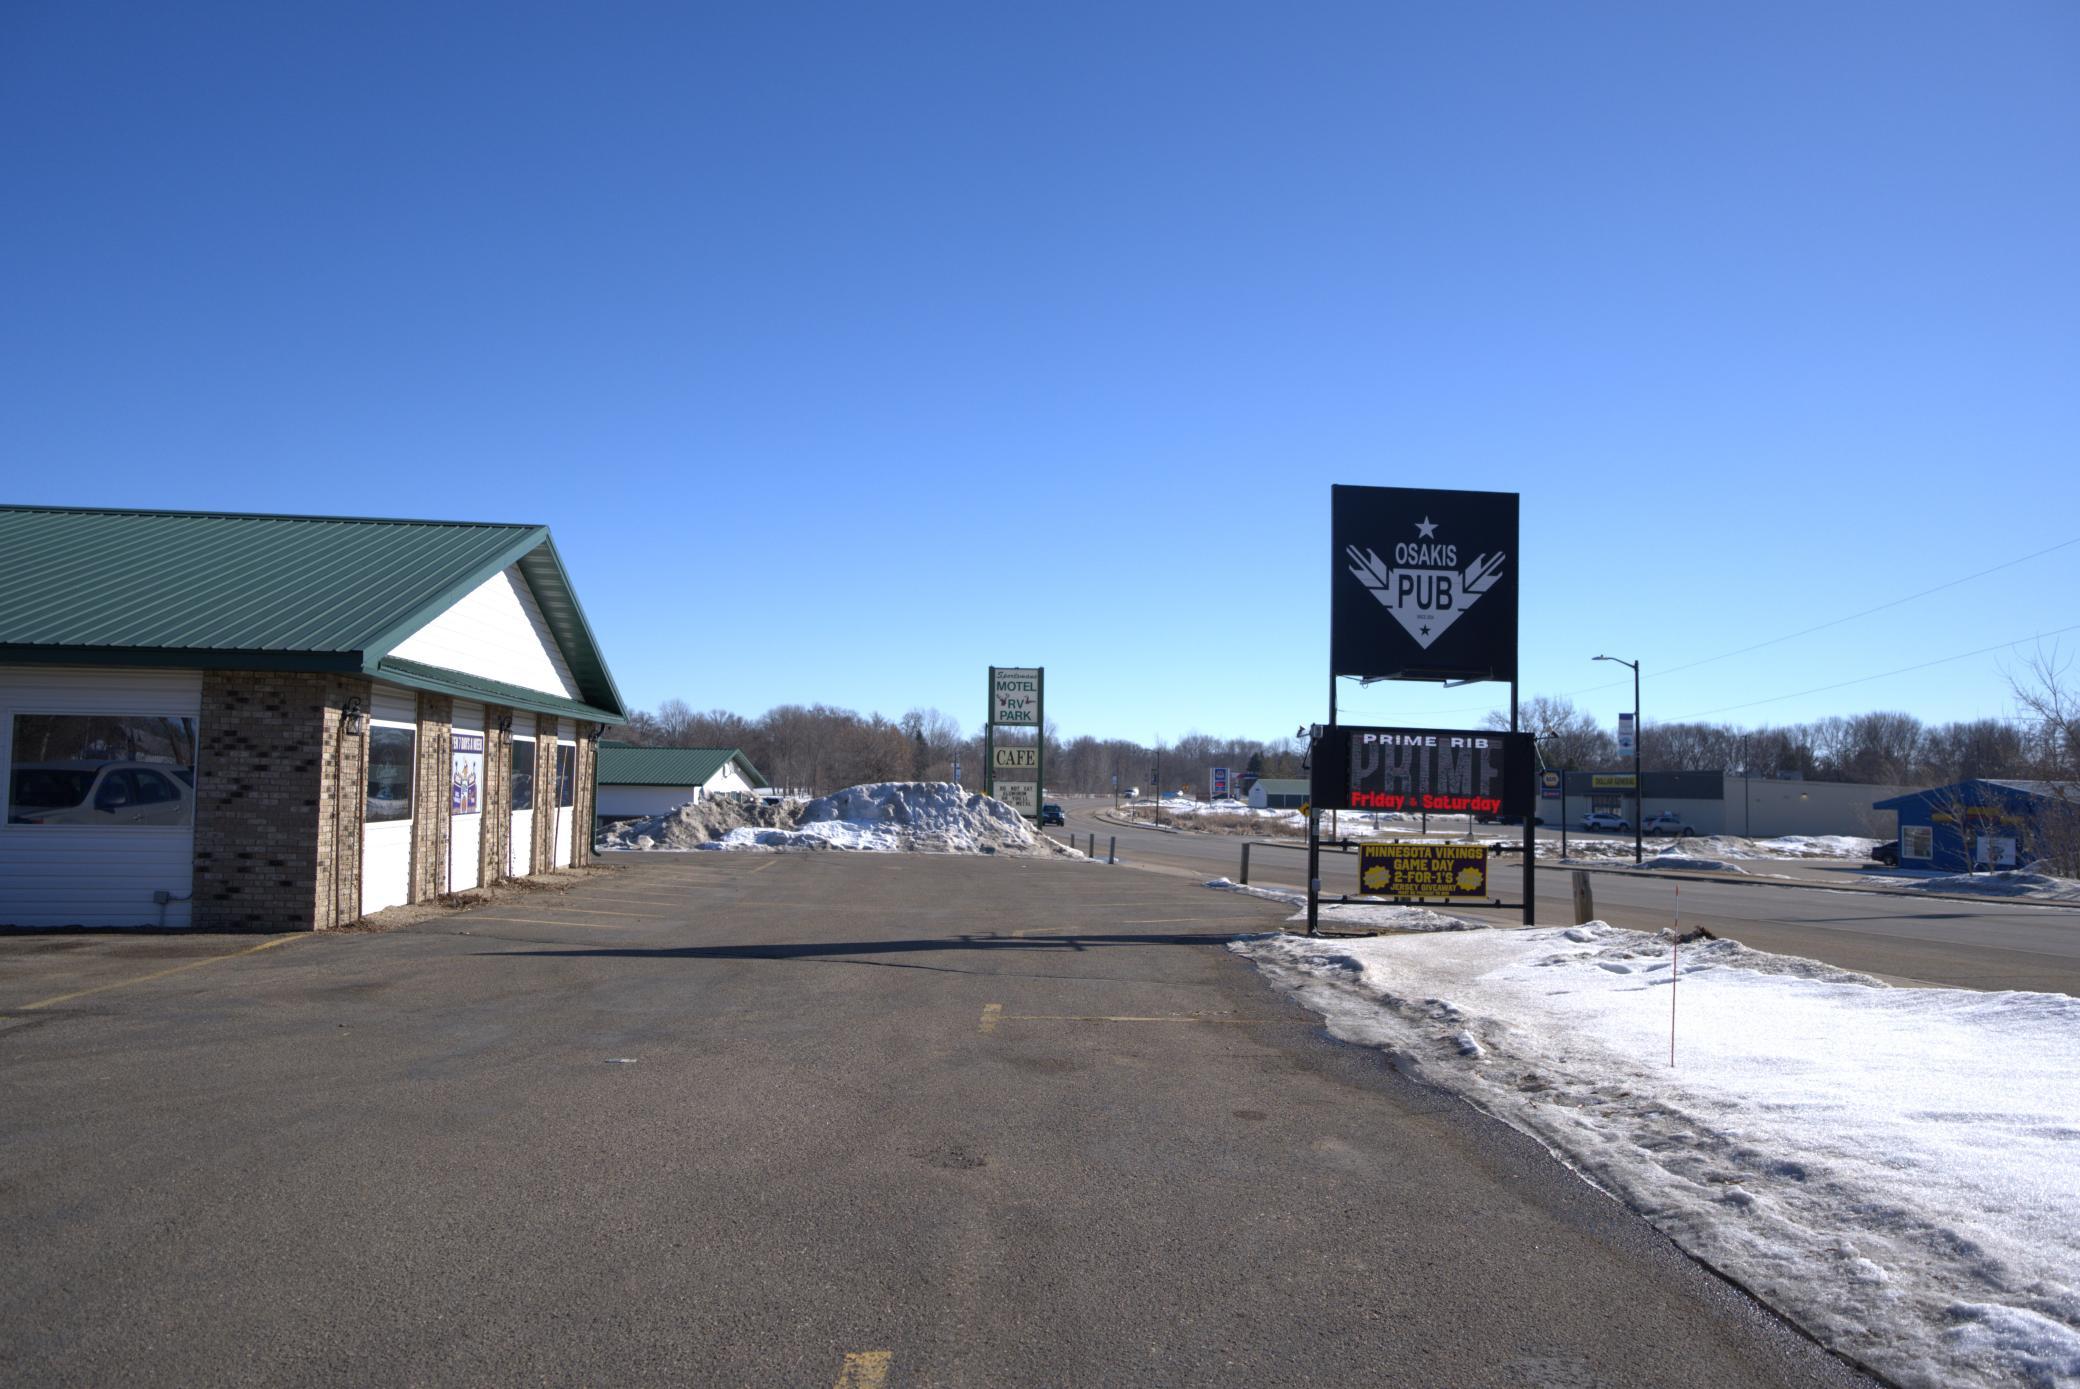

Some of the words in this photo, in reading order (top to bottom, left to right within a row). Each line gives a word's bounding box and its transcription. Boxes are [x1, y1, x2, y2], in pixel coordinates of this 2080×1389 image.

[1395, 542, 1457, 567] OSAKIS
[1398, 574, 1453, 610] PUB
[996, 681, 1036, 692] MOTEL
[1008, 699, 1024, 709] RV
[1000, 710, 1031, 721] PARK
[1363, 733, 1437, 747] PRIME
[1451, 737, 1489, 749] RIB
[996, 749, 1035, 766] CAFE
[1351, 792, 1404, 810] Friday
[1423, 795, 1502, 814] Saturday
[1365, 846, 1432, 858] MINNESOTA
[1435, 848, 1483, 859] VIKINGS
[1393, 859, 1428, 871] GAME
[1431, 860, 1455, 871] DAY
[1394, 871, 1454, 883] 2-FOR-1'S
[1390, 883, 1420, 892] JERSEY
[1421, 884, 1457, 893] GIVEAWAY
